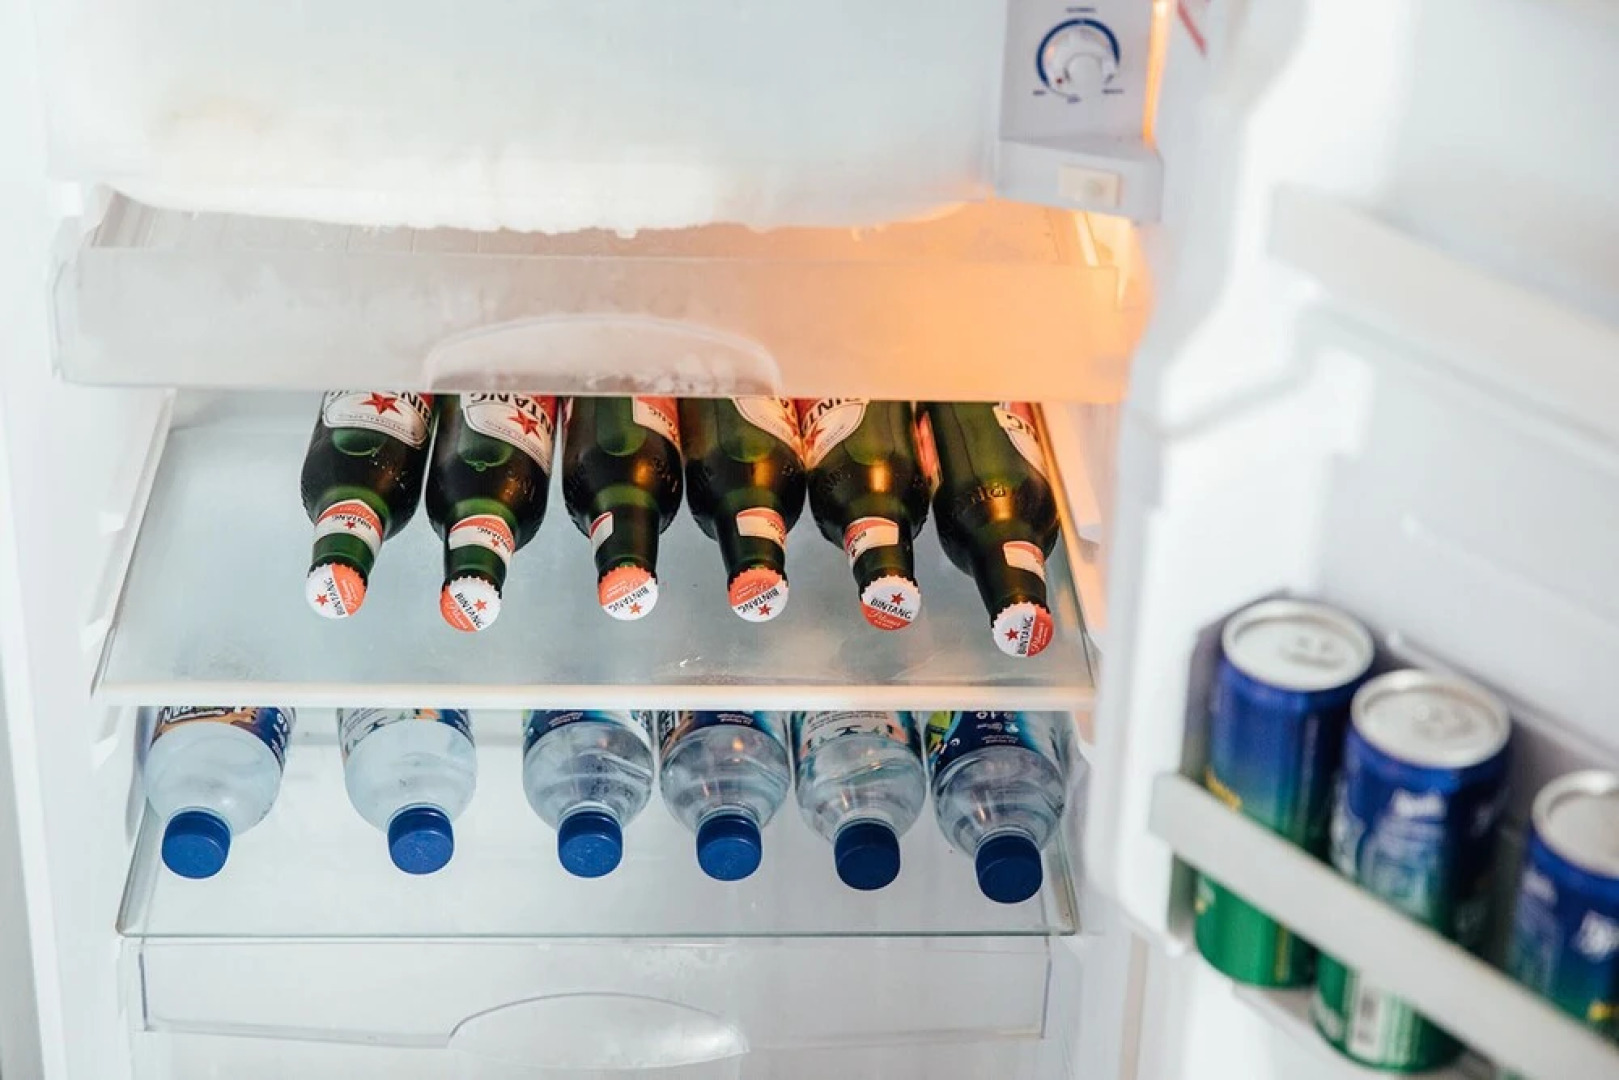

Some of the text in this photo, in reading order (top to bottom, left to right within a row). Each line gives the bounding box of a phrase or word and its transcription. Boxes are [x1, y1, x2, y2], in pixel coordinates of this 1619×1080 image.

[322, 577, 346, 616] BINTANG
[454, 592, 484, 629] BINTANG
[608, 585, 649, 613] BINTANG
[737, 587, 780, 613] BINTANG
[870, 597, 912, 620] BINTANG
[1016, 615, 1034, 655] BINTANG
